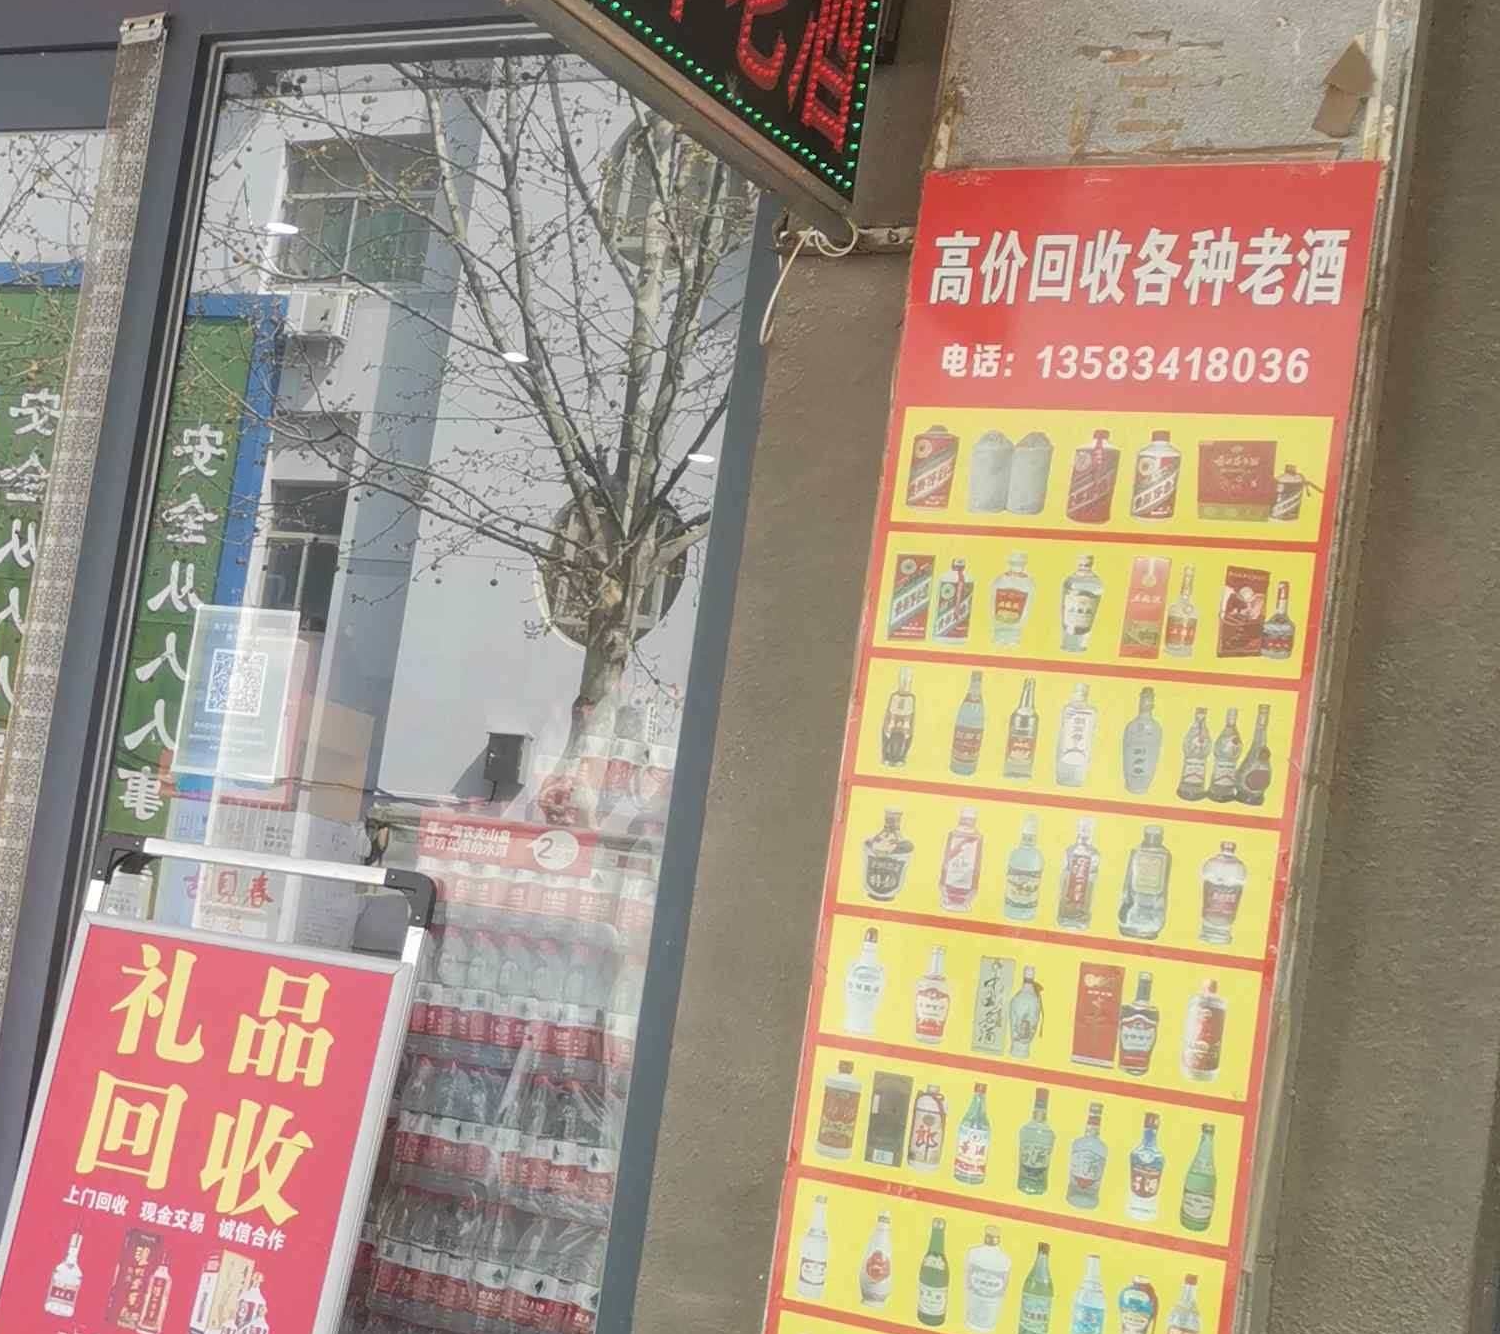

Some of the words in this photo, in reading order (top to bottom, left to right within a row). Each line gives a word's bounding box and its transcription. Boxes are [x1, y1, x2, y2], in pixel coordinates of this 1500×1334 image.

[930, 228, 1350, 307] 高价回收各种老酒
[1036, 345, 1310, 384] 13583418036
[108, 943, 335, 1087] 礼品
[75, 1069, 315, 1225] 回收
[62, 1184, 129, 1216] 上门回收
[139, 1201, 206, 1234] 现金交易
[217, 1218, 287, 1251] 诚信合作
